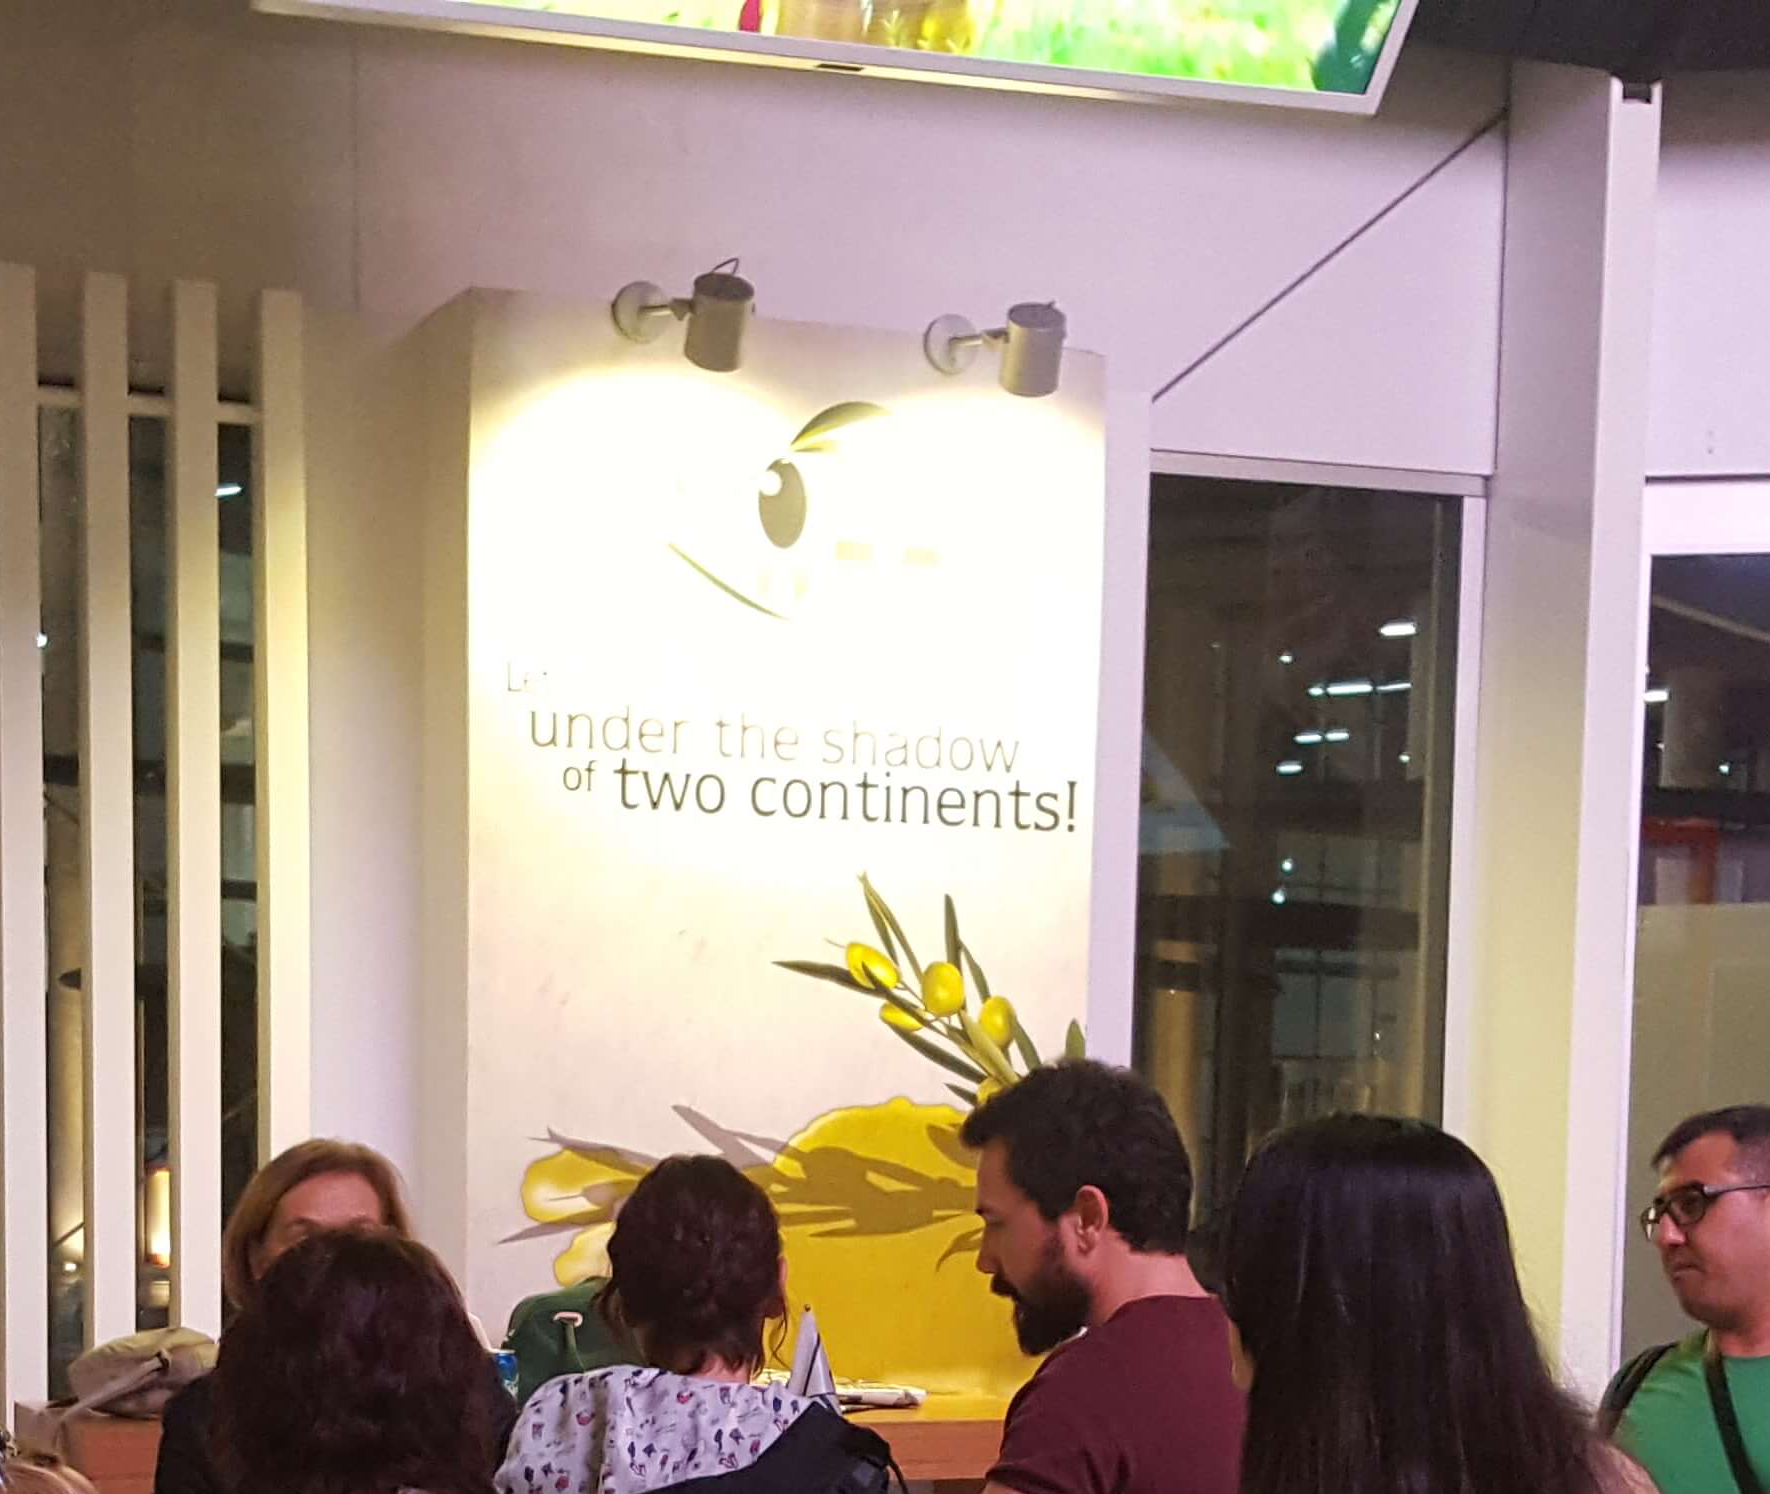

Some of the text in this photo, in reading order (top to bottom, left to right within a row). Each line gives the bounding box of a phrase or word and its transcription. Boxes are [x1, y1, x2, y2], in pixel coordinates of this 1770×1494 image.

[529, 705, 1021, 774] under the shadow
[562, 757, 1078, 834] of two continents!
